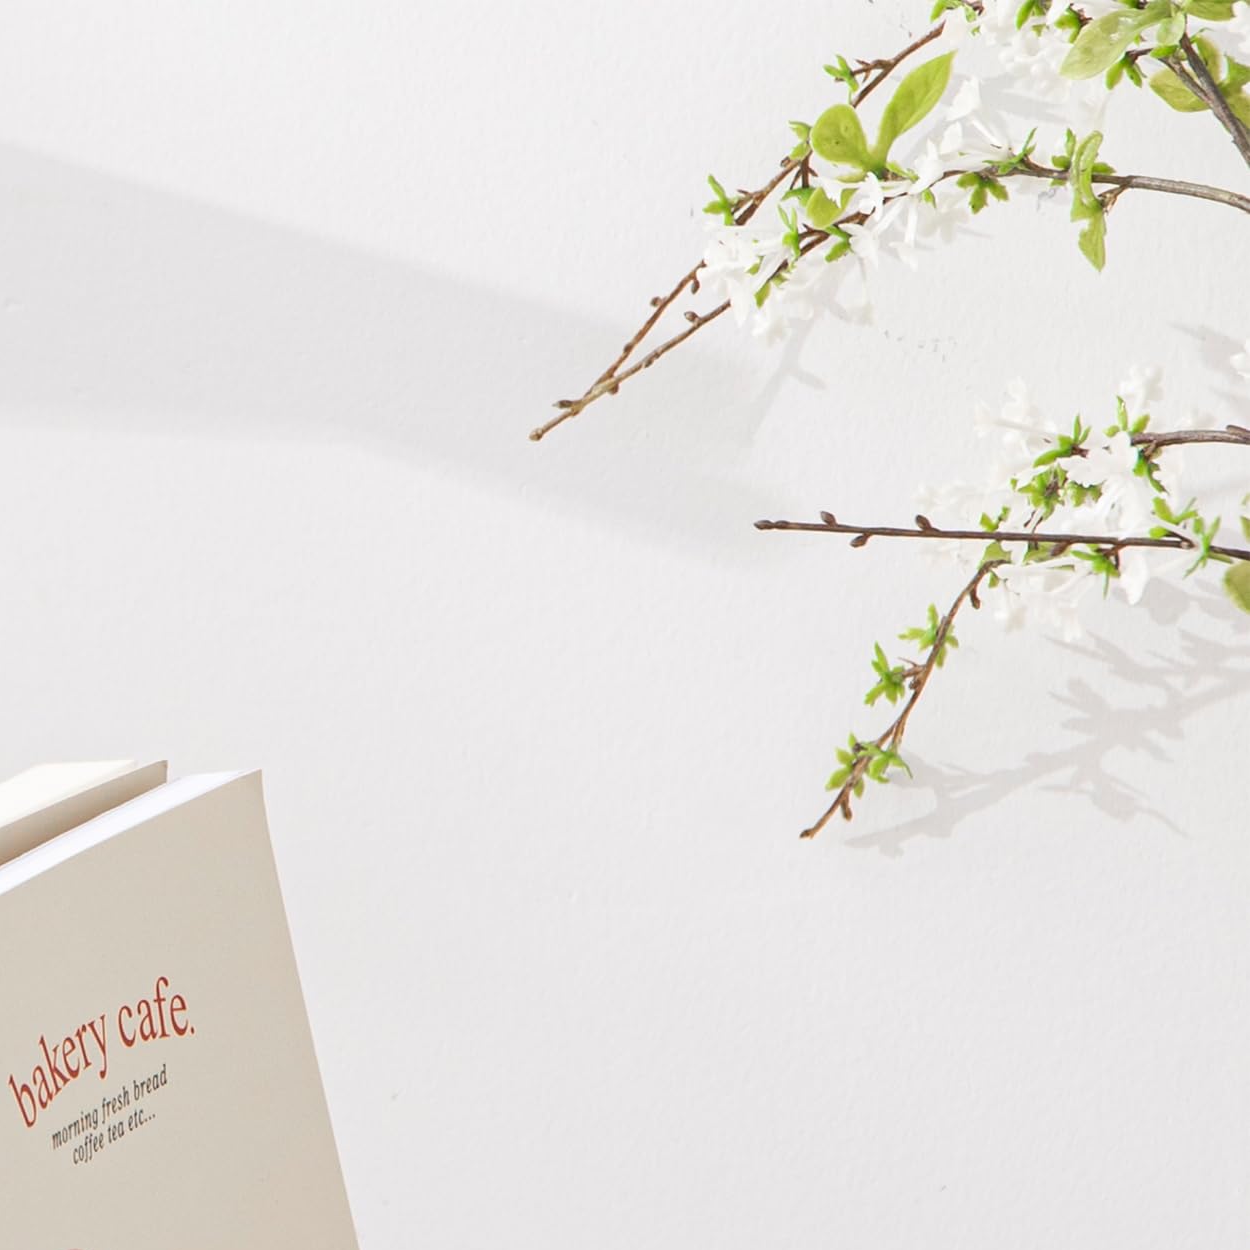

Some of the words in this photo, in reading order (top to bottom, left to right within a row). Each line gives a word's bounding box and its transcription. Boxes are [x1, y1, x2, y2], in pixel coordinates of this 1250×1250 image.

[8, 1013, 107, 1128] bakery
[118, 976, 196, 1048] cafe.
[51, 1111, 99, 1150] morning
[101, 1086, 130, 1124] fresh
[133, 1063, 168, 1101] bread
[73, 1133, 104, 1165] coffee
[107, 1121, 125, 1144] tea
[128, 1109, 156, 1132] etc...
